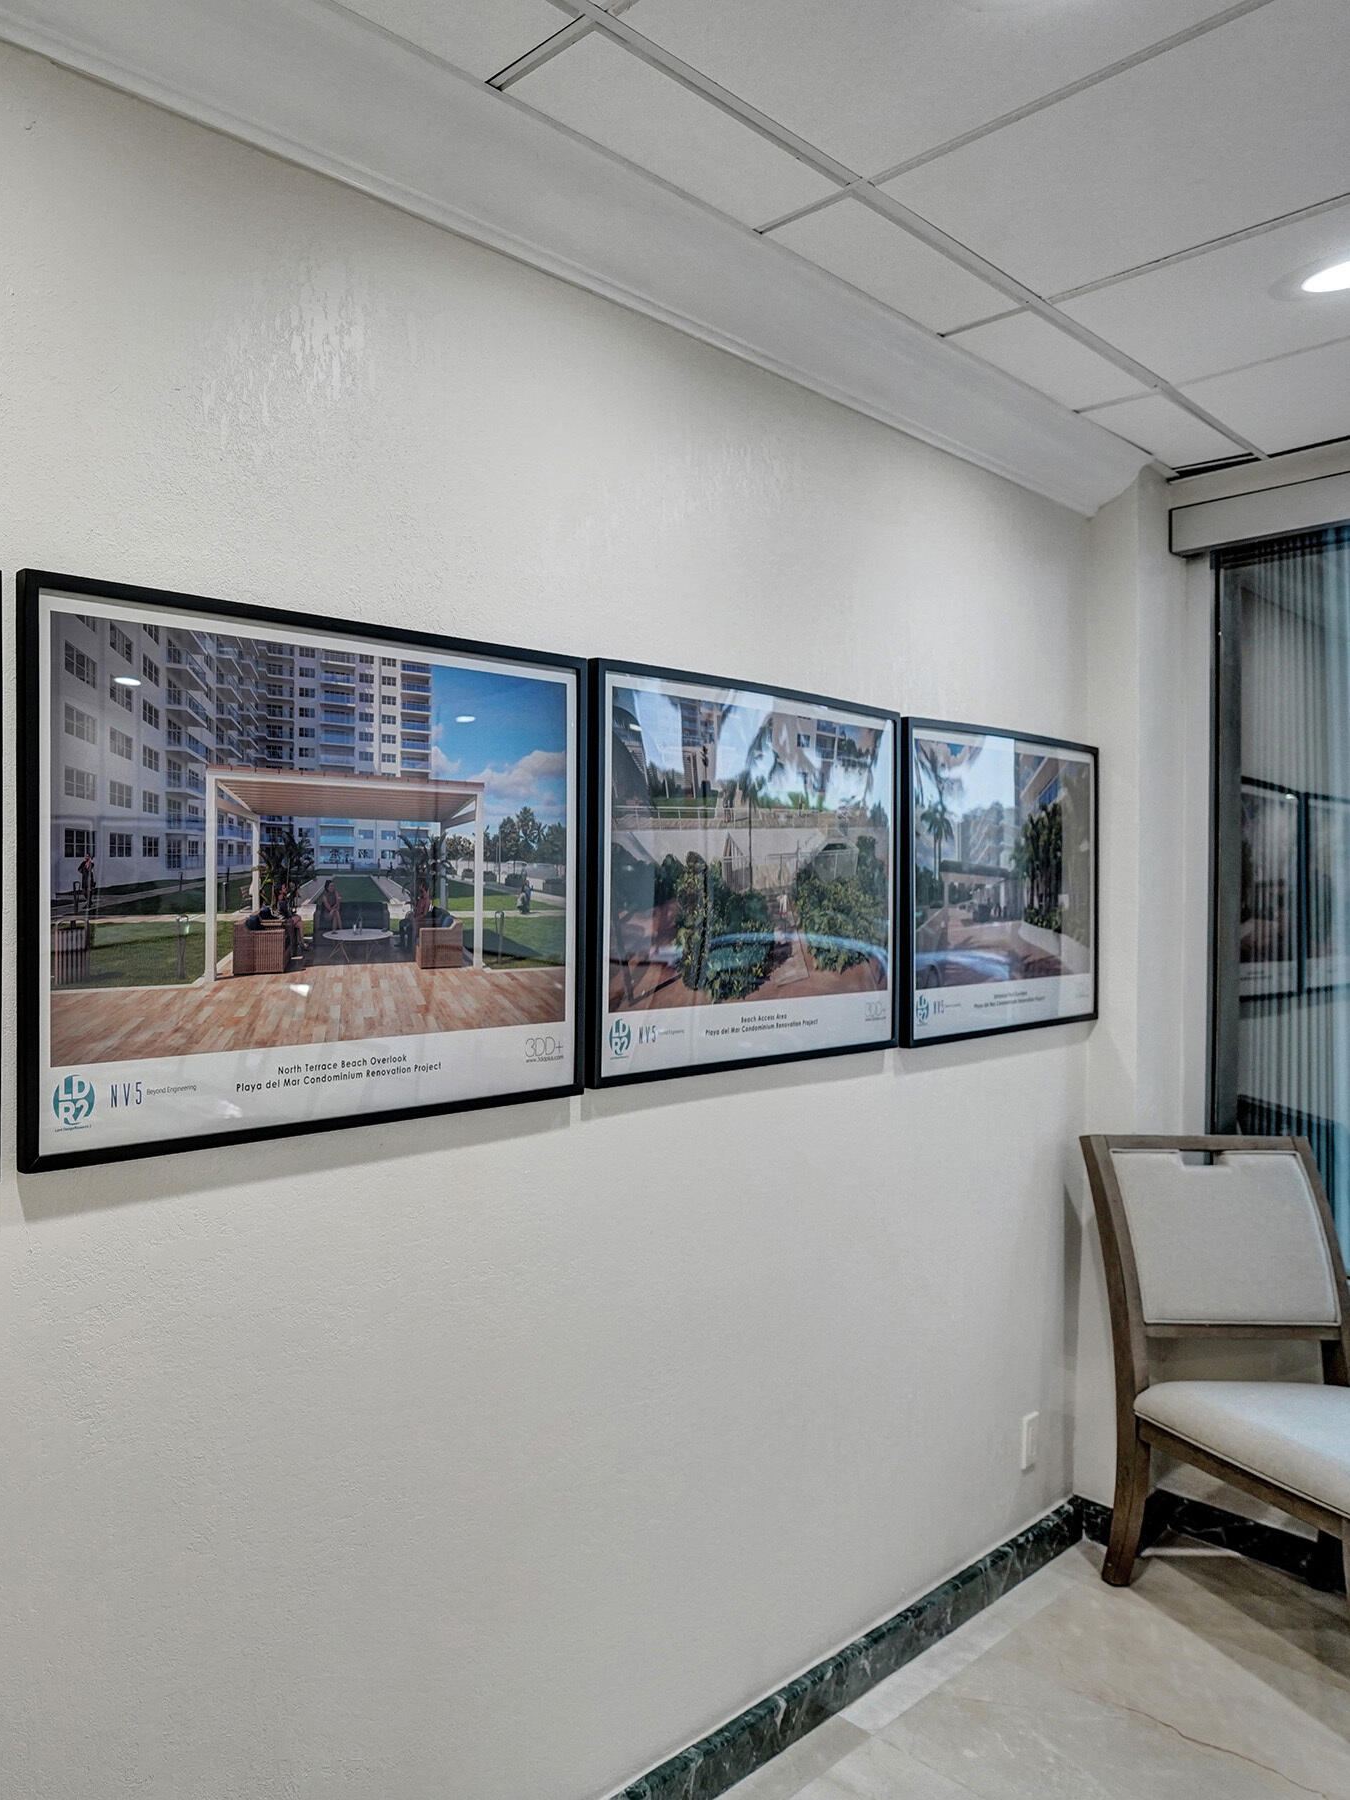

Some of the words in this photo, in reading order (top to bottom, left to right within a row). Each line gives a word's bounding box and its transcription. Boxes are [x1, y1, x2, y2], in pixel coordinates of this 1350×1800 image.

[721, 1027, 730, 1035] del
[742, 1023, 775, 1032] Condominium
[776, 1020, 801, 1029] Renovation
[802, 1018, 818, 1026] Project
[740, 1015, 756, 1023] Beach
[277, 1065, 302, 1075] North
[305, 1062, 337, 1072] Terrace
[341, 1058, 367, 1069] Beach
[370, 1054, 407, 1065] Overlook
[236, 1083, 262, 1092] Playa
[265, 1080, 280, 1089] del
[283, 1078, 300, 1087] Mar
[303, 1071, 363, 1085] Condominium
[366, 1065, 411, 1078] Renovation
[414, 1061, 441, 1073] Project
[58, 1076, 90, 1100] LD
[110, 1081, 142, 1108] NV5
[146, 1087, 166, 1096] Beyond
[167, 1085, 197, 1094] Engineering
[58, 1100, 89, 1125] R2
